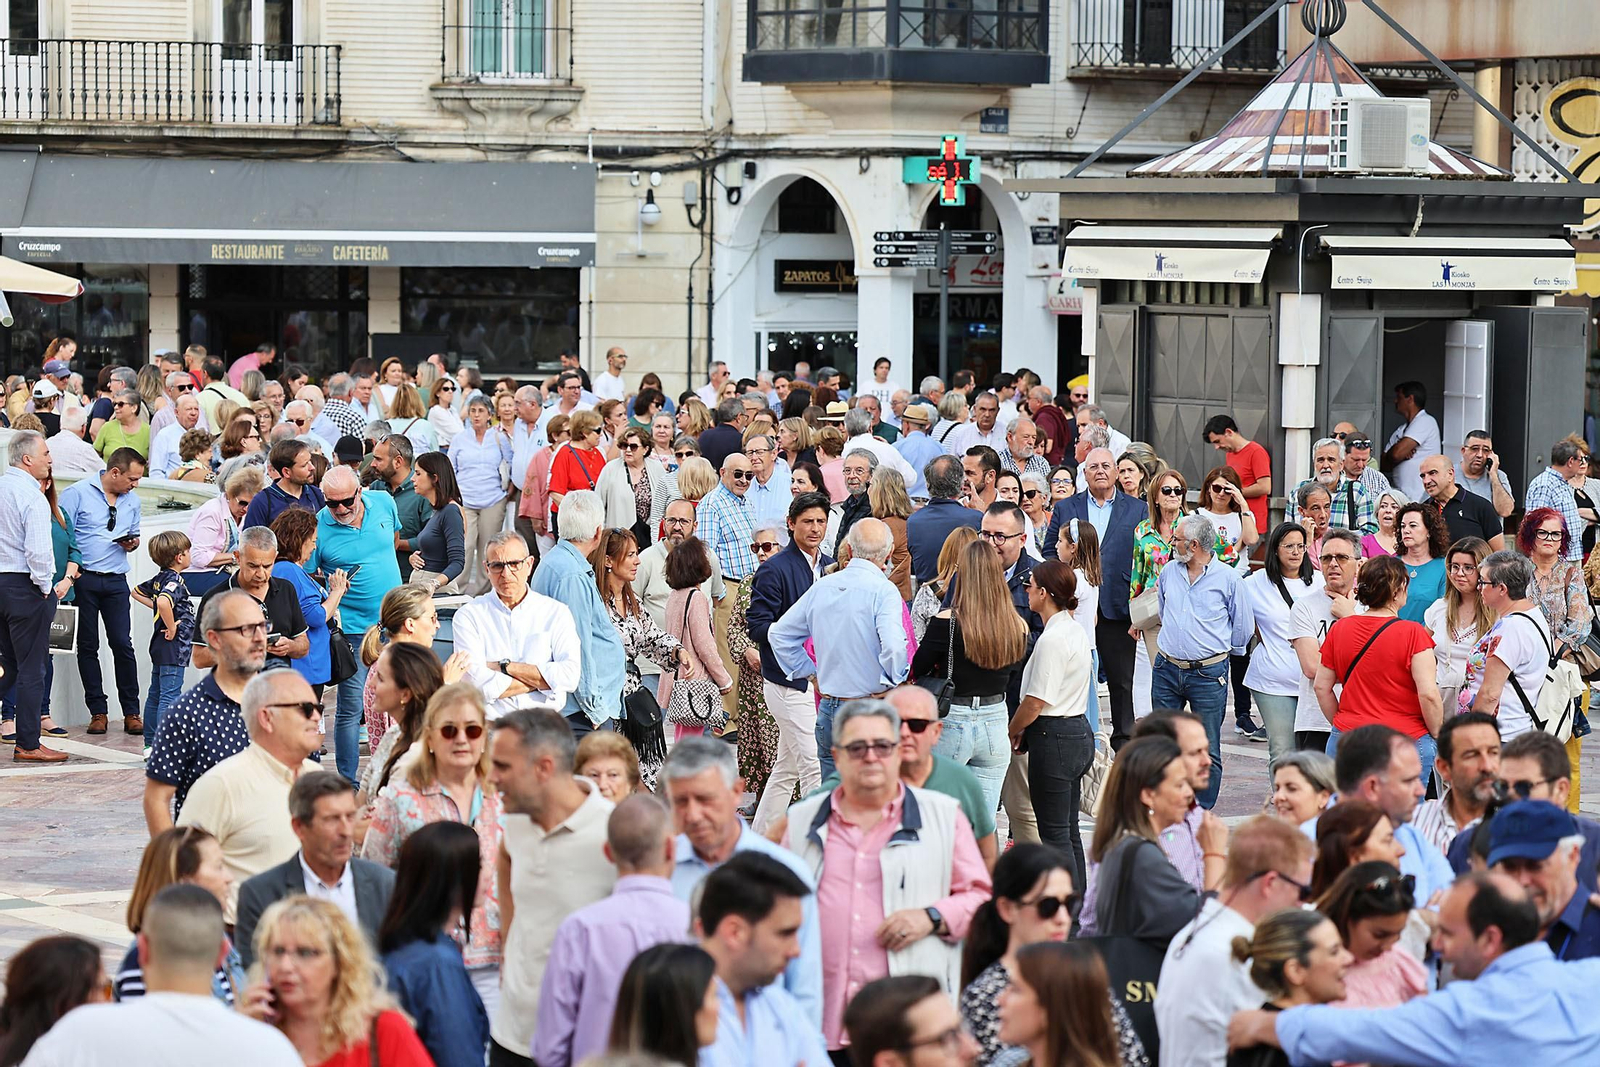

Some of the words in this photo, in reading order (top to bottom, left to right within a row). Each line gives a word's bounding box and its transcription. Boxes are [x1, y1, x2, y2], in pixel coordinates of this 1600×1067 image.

[18, 241, 61, 252] Cruzcampo
[211, 244, 285, 259] RESTAURANTE
[538, 246, 580, 257] Cruzcampo
[332, 244, 389, 261] CAFETERÍA
[784, 270, 831, 282] ZAPATOS
[1337, 275, 1354, 284] Centro
[1451, 270, 1471, 278] Kiosko
[1533, 277, 1551, 286] Centro
